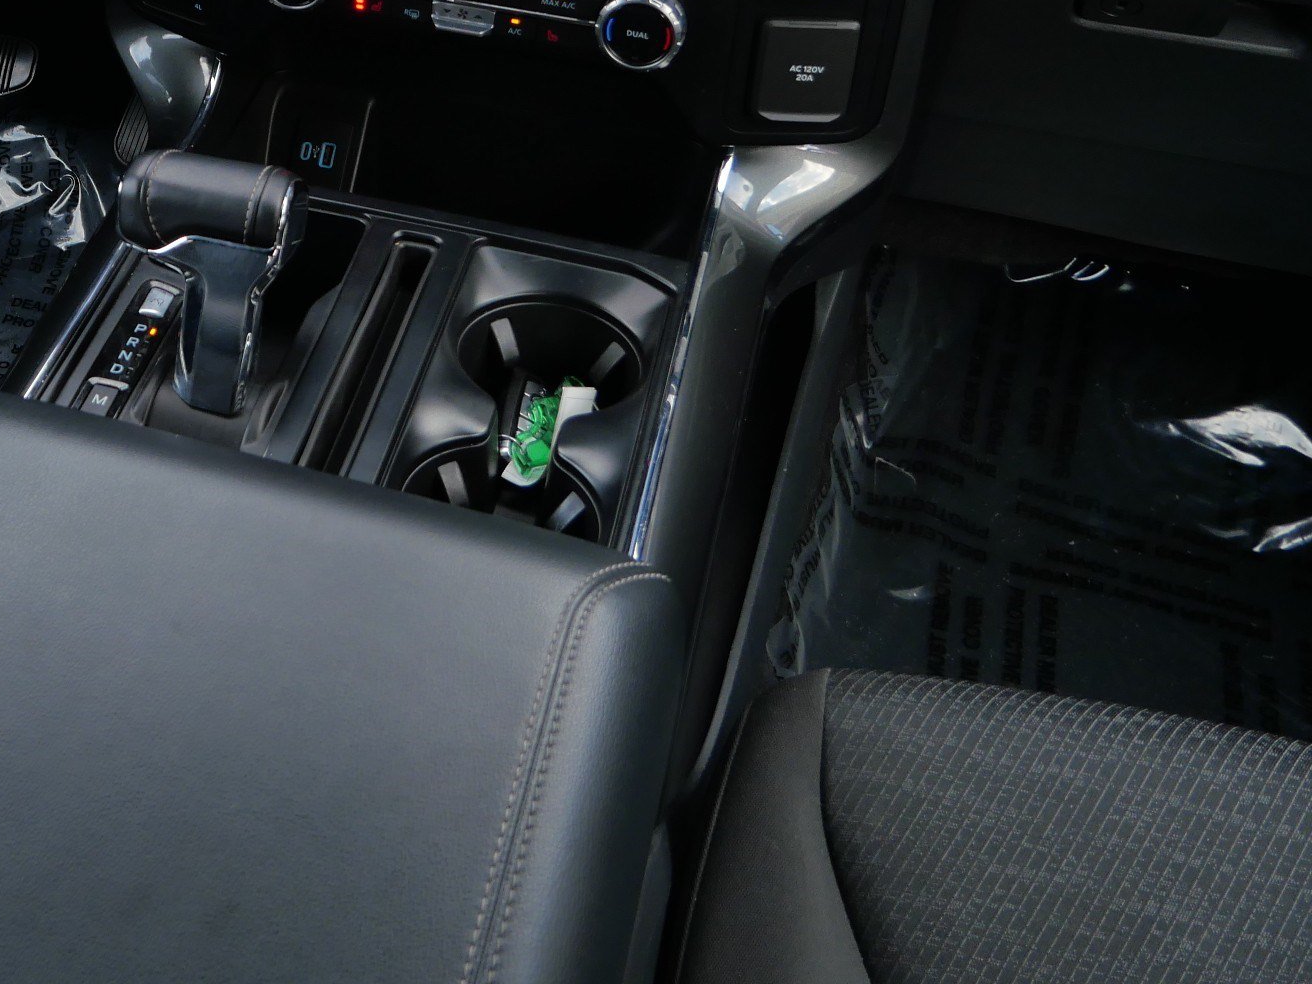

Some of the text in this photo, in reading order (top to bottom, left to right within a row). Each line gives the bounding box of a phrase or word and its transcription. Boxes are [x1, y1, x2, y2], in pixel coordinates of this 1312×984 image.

[194, 2, 203, 12] 4L
[562, 0, 576, 11] A/C
[507, 27, 522, 37] A/C
[626, 29, 649, 41] DUAL
[789, 64, 825, 74] AC 120V
[795, 73, 814, 83] 20A
[134, 323, 147, 333] P
[126, 336, 140, 348] R
[118, 349, 134, 361] N
[109, 363, 124, 375] D
[91, 393, 108, 406] M
